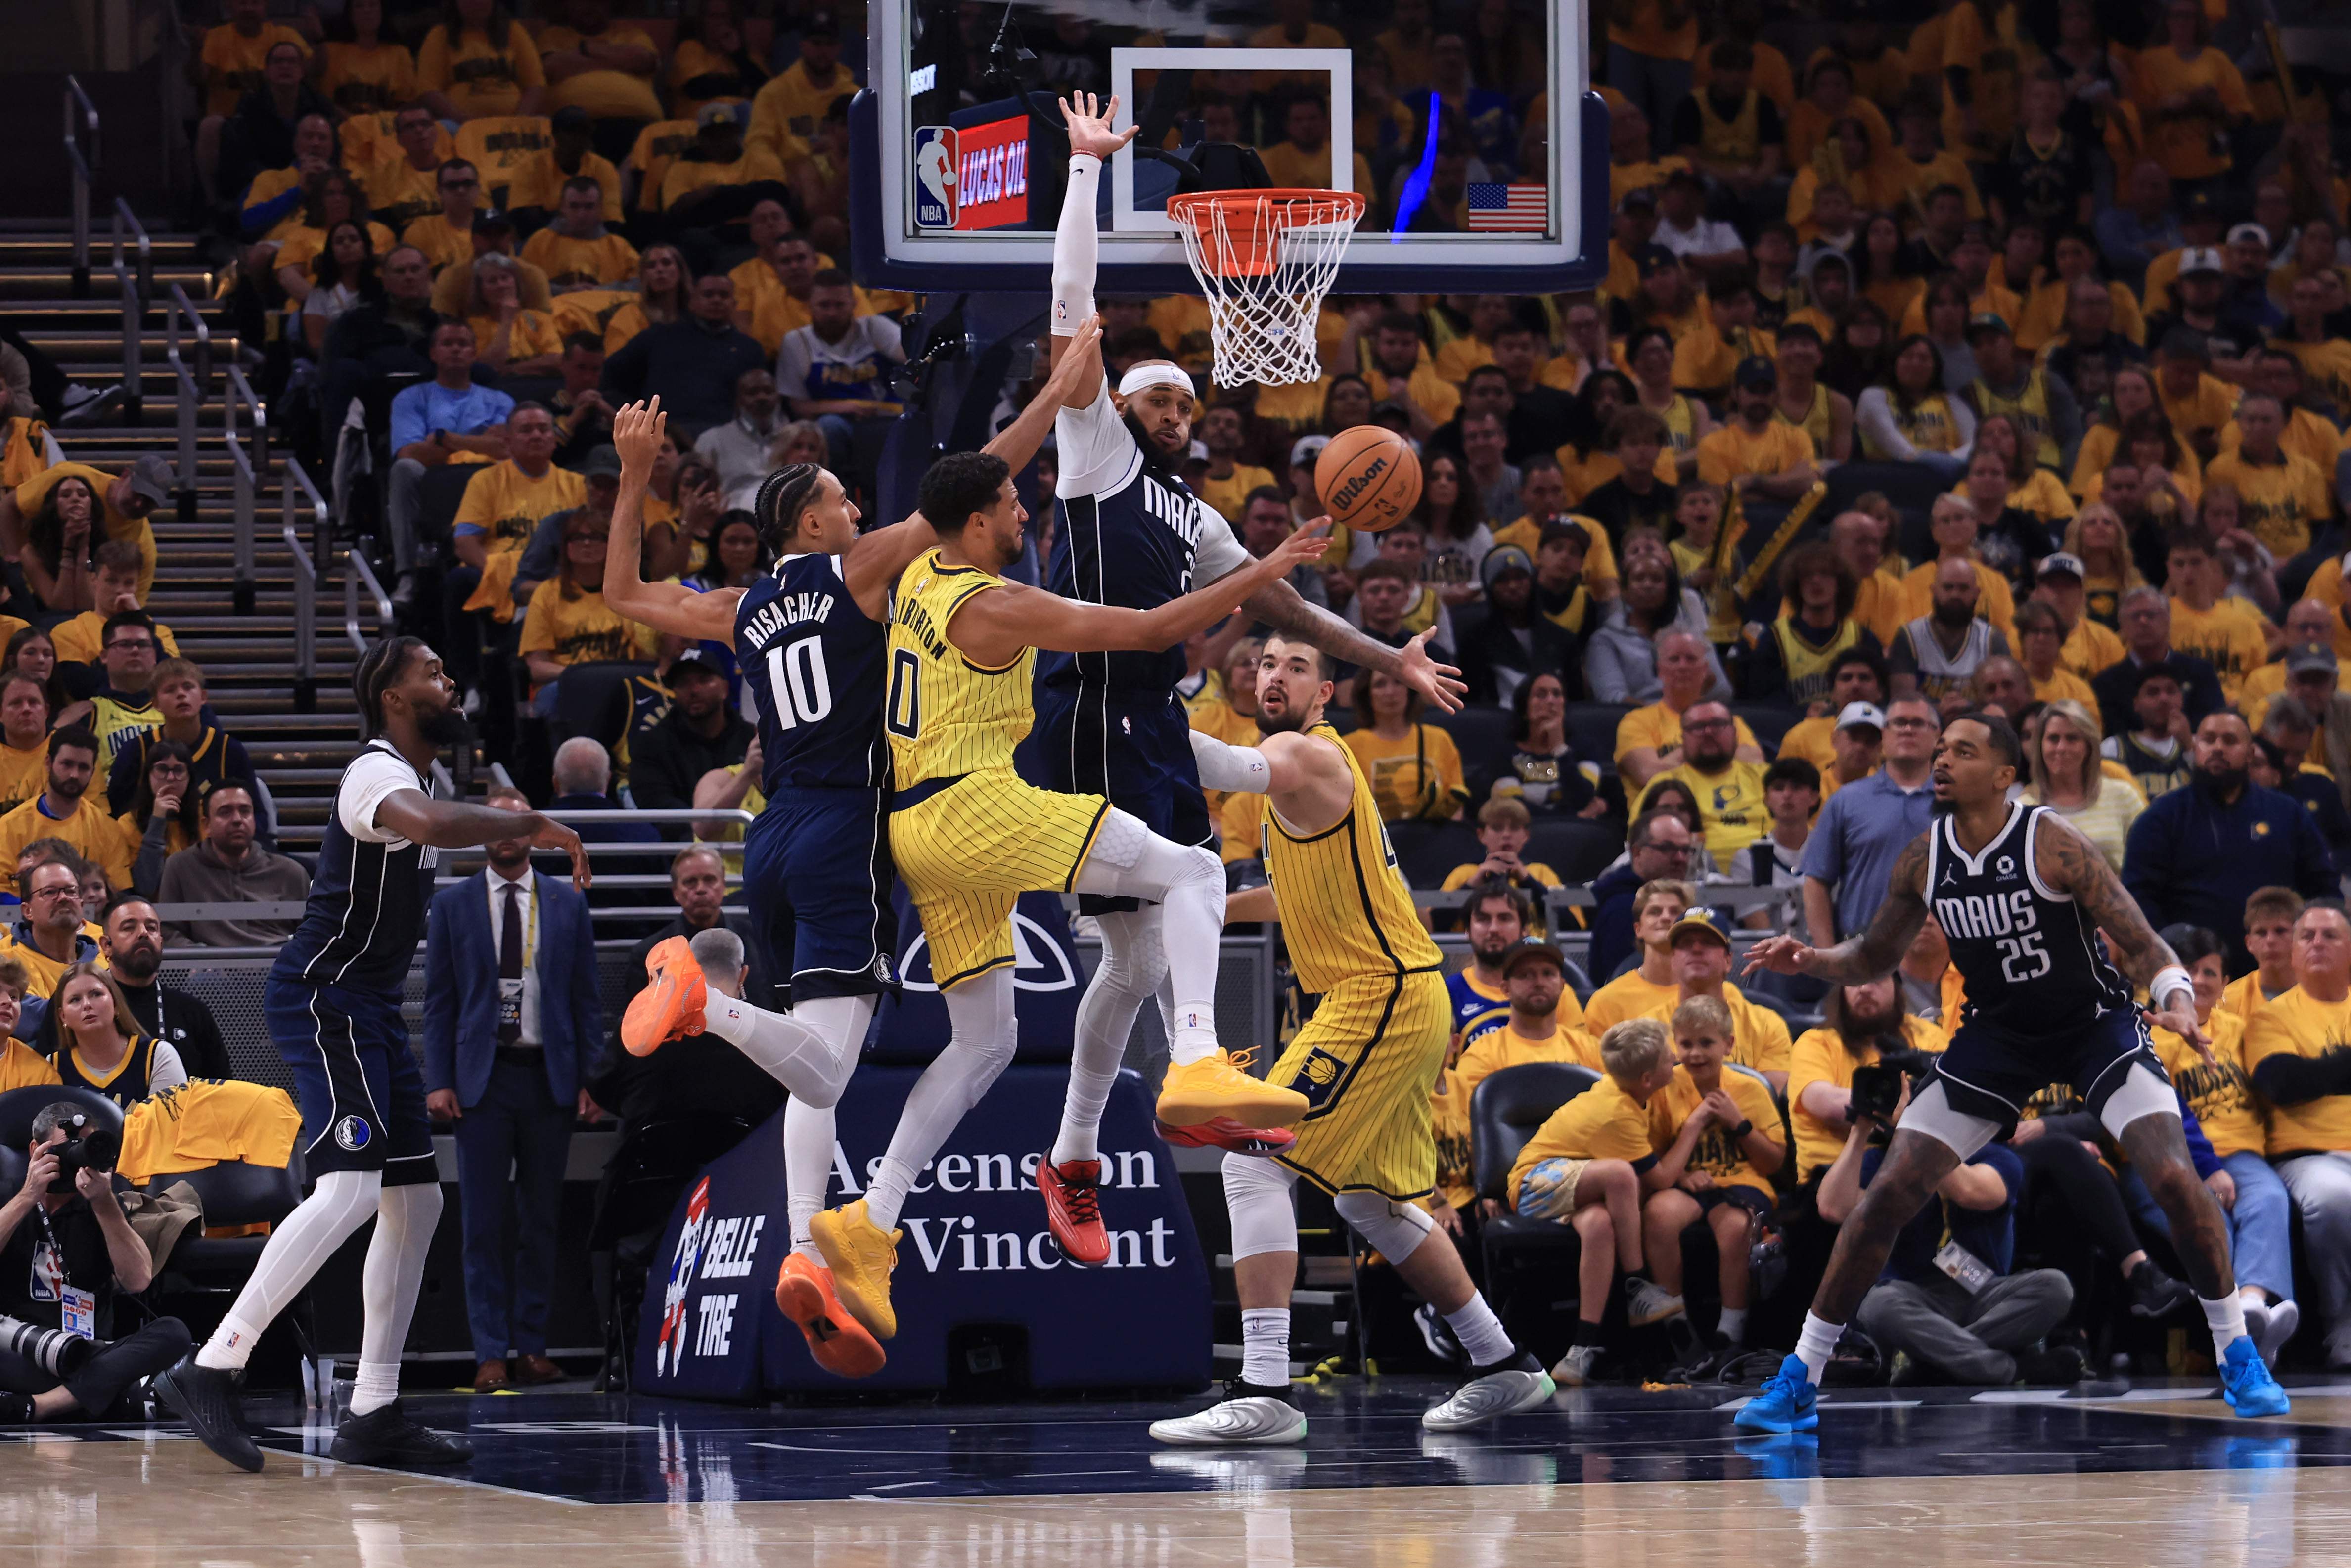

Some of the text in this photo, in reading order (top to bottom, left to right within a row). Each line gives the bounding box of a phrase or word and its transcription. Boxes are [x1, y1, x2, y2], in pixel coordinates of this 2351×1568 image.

[958, 139, 1027, 208] LUCAS OIL
[921, 205, 942, 222] NBA
[1331, 457, 1388, 511] Wilson
[743, 591, 834, 650] RISACHER
[766, 635, 832, 730] 10
[885, 646, 921, 742] 0
[1996, 873, 2018, 882] CHASE
[1935, 888, 2037, 939] MAVS
[1996, 930, 2051, 983] 25
[829, 1139, 1160, 1194] Aensn
[700, 1214, 766, 1279] BELLE
[902, 1215, 1176, 1273] Vincnt
[35, 1289, 51, 1298] NBA
[695, 1294, 739, 1356] TIRE
